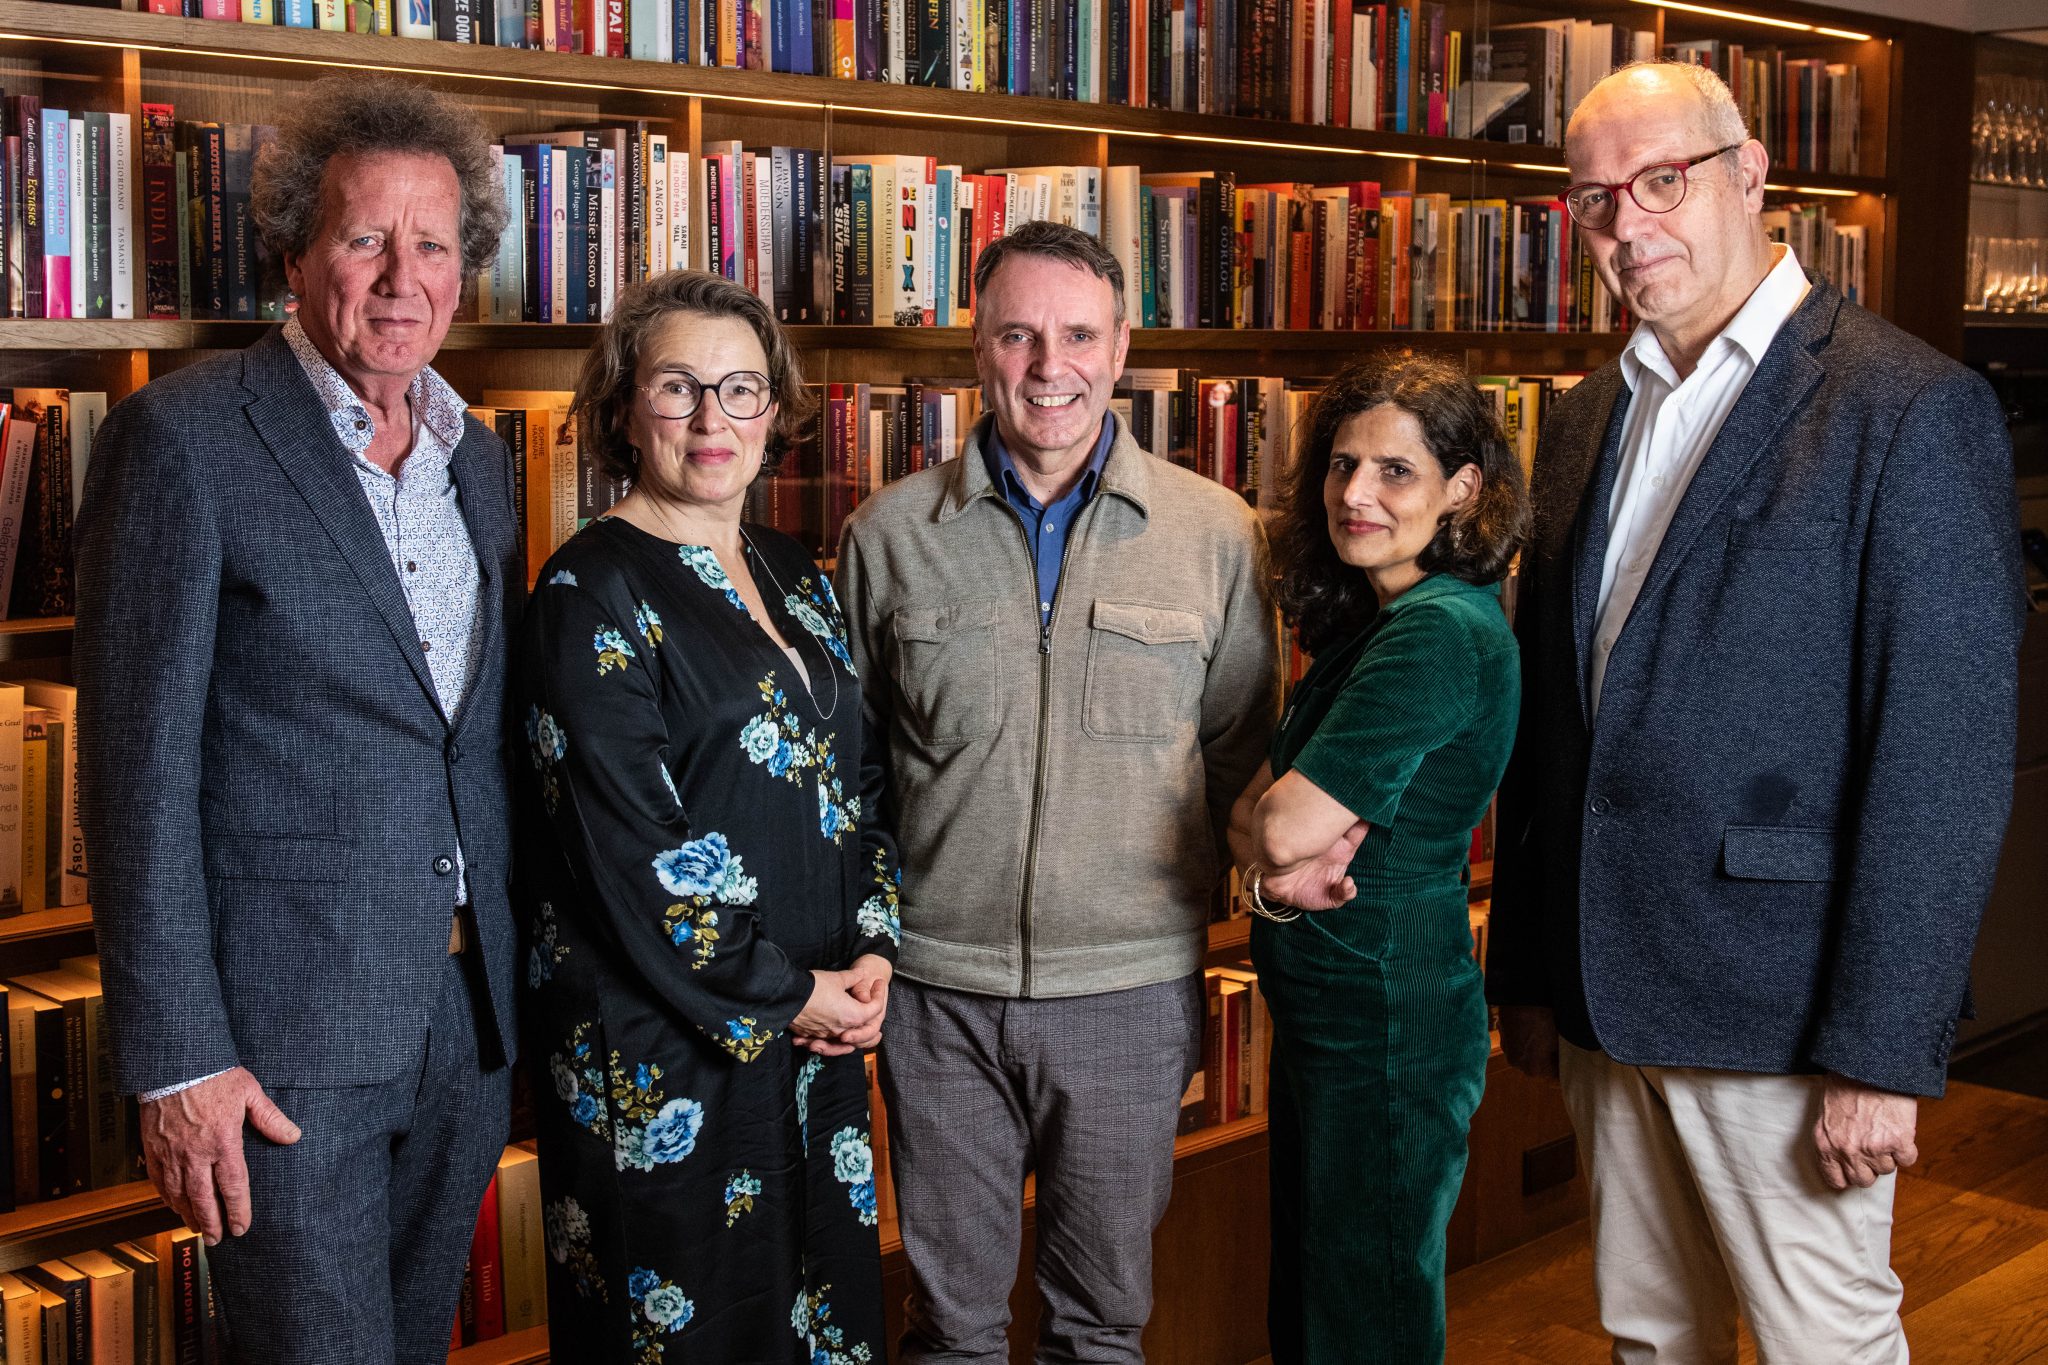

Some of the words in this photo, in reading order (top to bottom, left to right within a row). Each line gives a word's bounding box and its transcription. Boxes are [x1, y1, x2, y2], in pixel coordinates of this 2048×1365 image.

[678, 31, 687, 54] TAFEL
[27, 117, 36, 138] Carlo
[57, 121, 67, 163] Paolo
[92, 126, 98, 137] De
[116, 126, 124, 158] PAOLO
[27, 141, 37, 176] Ginzburg
[210, 133, 221, 191] EXOTISCH
[572, 159, 581, 189] George
[632, 142, 640, 199] REASONABLE
[745, 161, 753, 171] De
[117, 159, 125, 210] GIORDANO
[710, 165, 718, 199] NOREENA
[745, 173, 754, 185] Tol
[746, 186, 754, 200] van
[774, 156, 783, 209] HEWSON
[1010, 174, 1015, 184] DE
[1220, 180, 1230, 211] Jenni
[48, 194, 56, 235] lichaam
[57, 168, 68, 235] Giordano
[92, 213, 98, 224] de
[150, 179, 167, 244] INDIA
[572, 191, 582, 219] Hagen
[588, 194, 598, 239] Missie:
[632, 201, 640, 229] FAITH
[655, 178, 664, 226] SANGOMA
[711, 201, 719, 224] HERTZ
[746, 201, 754, 213] de
[759, 179, 771, 255] MOEDERSCHAP
[856, 200, 867, 229] OSCAR
[211, 194, 222, 252] AMERIKA
[556, 230, 564, 243] De
[711, 225, 719, 236] DE
[1348, 203, 1357, 259] WILLIAM
[91, 225, 99, 281] priemgetallen
[235, 214, 247, 286] Tempelridder
[555, 245, 564, 274] joodse
[711, 237, 719, 261] STILLE
[834, 207, 844, 292] SILVERFIN
[856, 231, 868, 276] HIJUELOS
[885, 218, 893, 270] HIJUELOS
[1160, 219, 1170, 272] Stanley
[1220, 225, 1229, 292] OORLOG
[508, 252, 518, 291] handen
[588, 241, 598, 288] Kosovo
[940, 277, 946, 285] de
[1364, 257, 1372, 296] LEVEN
[557, 277, 565, 301] bruid
[938, 287, 946, 297] pil
[845, 395, 853, 423] Terug
[915, 391, 922, 400] TO
[53, 408, 62, 447] HITLERS
[846, 426, 854, 438] uit
[565, 451, 575, 489] GODS
[846, 441, 854, 472] Afrika
[586, 466, 594, 507] Moederziel
[27, 749, 34, 760] DE
[72, 836, 83, 872] JOBS
[182, 1246, 192, 1267] MO
[182, 1269, 193, 1325] HAYDER
[480, 1261, 493, 1301] Tonio
[75, 1327, 84, 1360] GROULT
